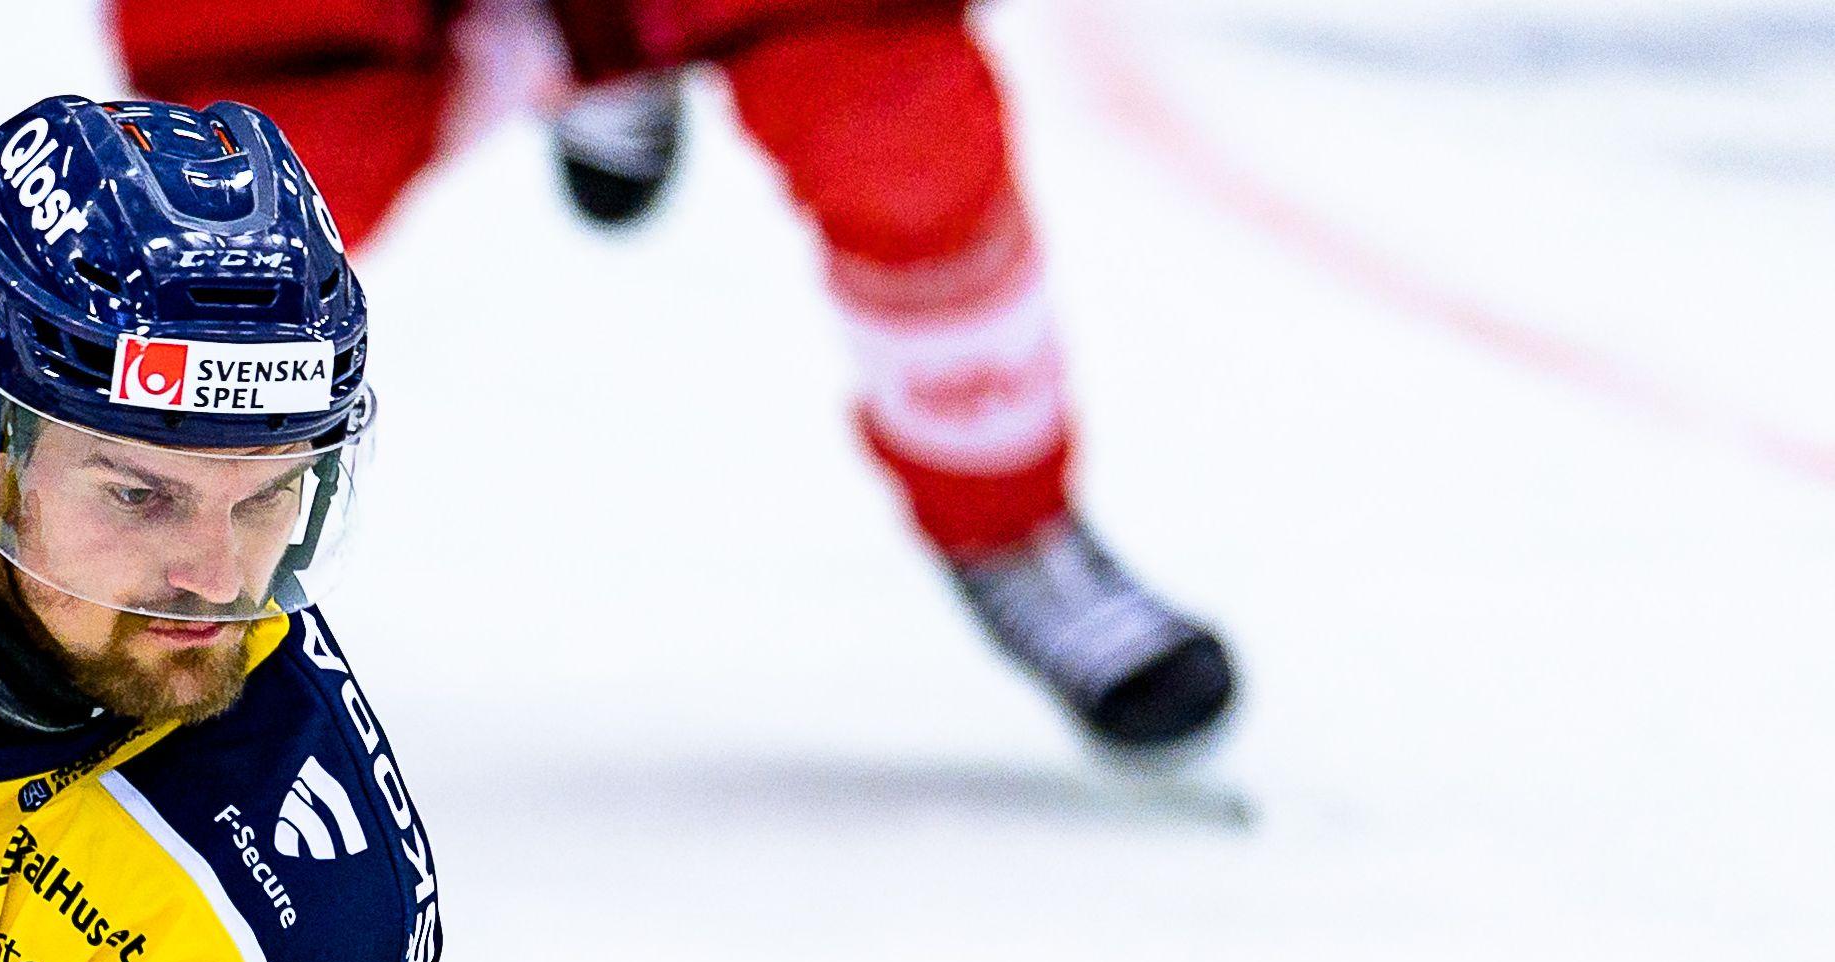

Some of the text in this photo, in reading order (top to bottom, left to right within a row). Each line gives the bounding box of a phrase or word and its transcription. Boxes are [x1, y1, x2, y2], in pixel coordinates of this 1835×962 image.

[1, 118, 89, 246] Qlost
[179, 250, 284, 268] CCM
[197, 359, 326, 383] SVENSKA
[193, 386, 264, 409] SPEL
[213, 804, 297, 929] F-Secure
